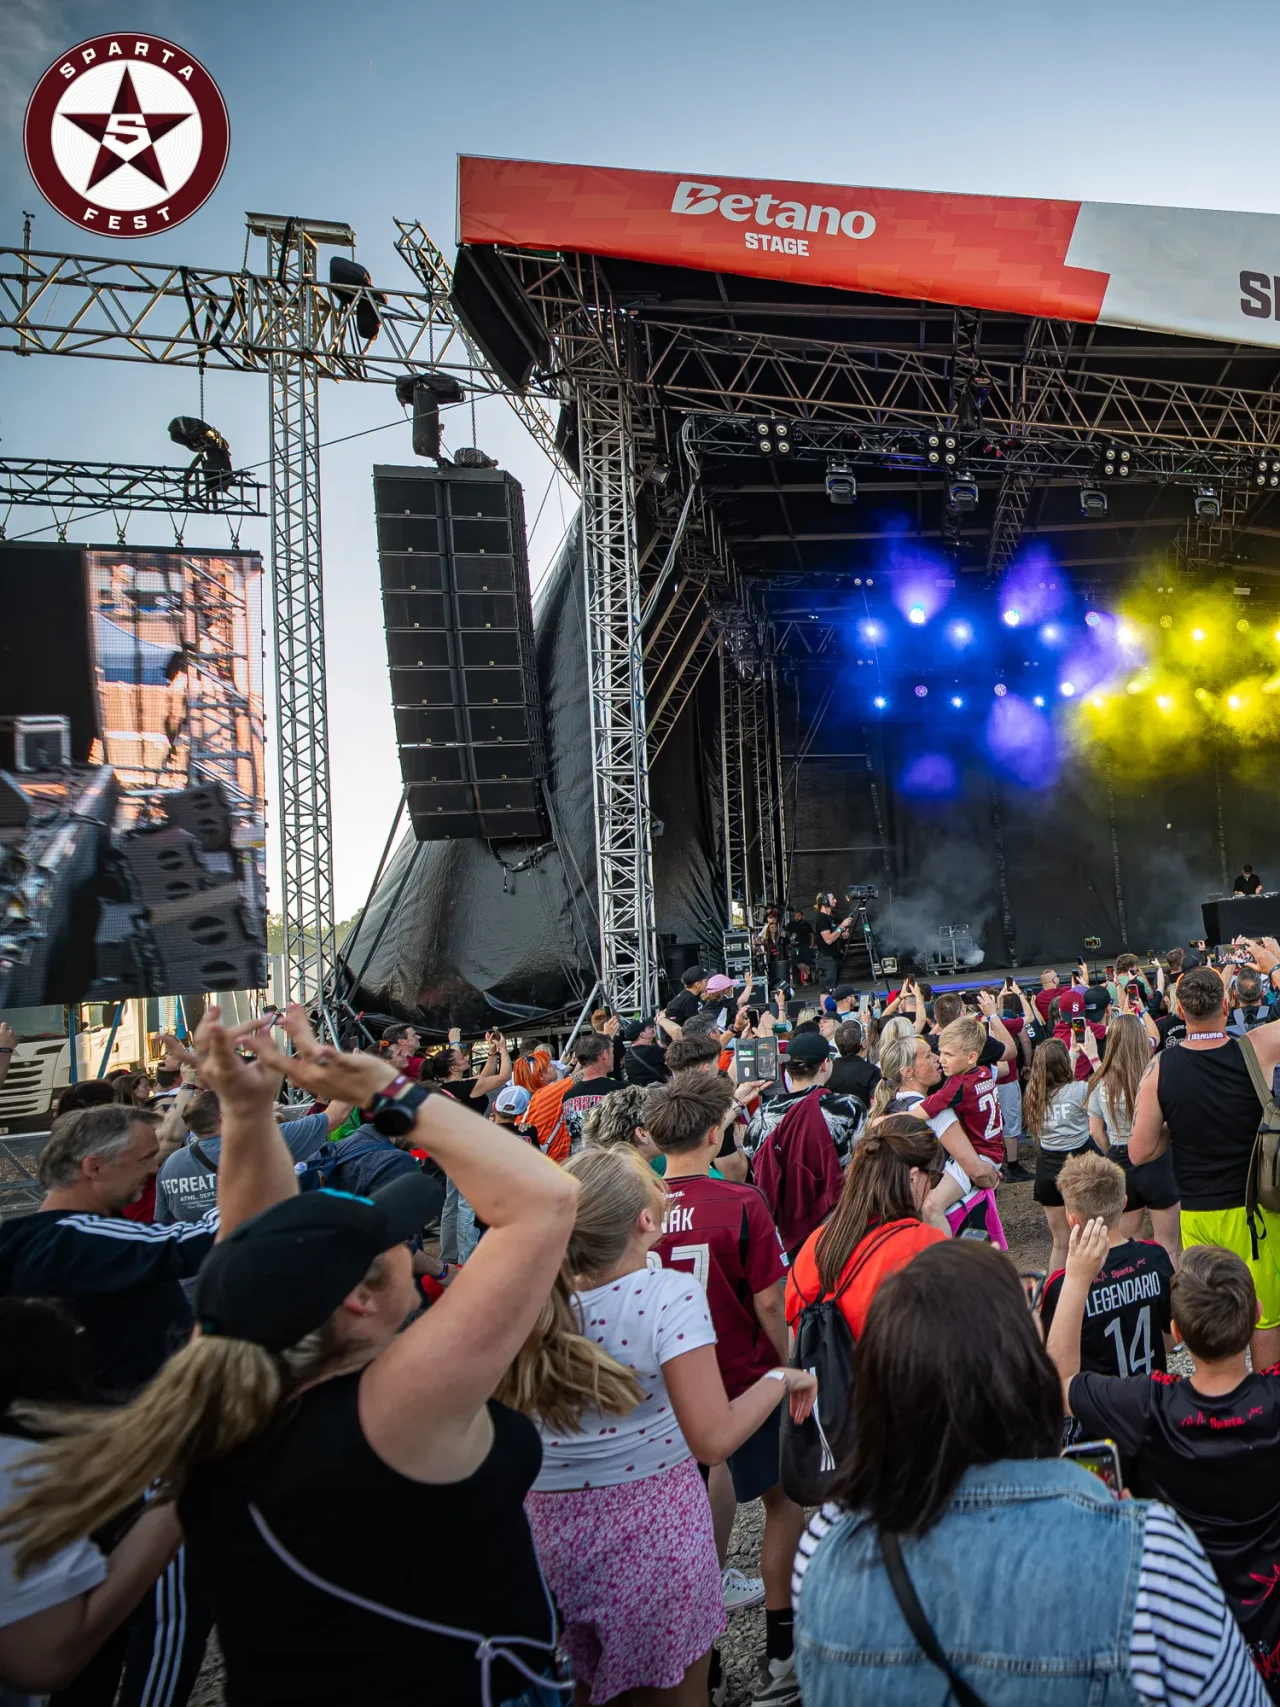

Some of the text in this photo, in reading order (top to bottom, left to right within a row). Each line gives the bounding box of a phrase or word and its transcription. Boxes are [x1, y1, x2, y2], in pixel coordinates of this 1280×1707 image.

[671, 181, 876, 240] Betano
[745, 232, 810, 257] STAGE
[1072, 1003, 1079, 1012] S
[1085, 1270, 1161, 1318] LEGENDARIO
[1103, 1304, 1155, 1380] 14
